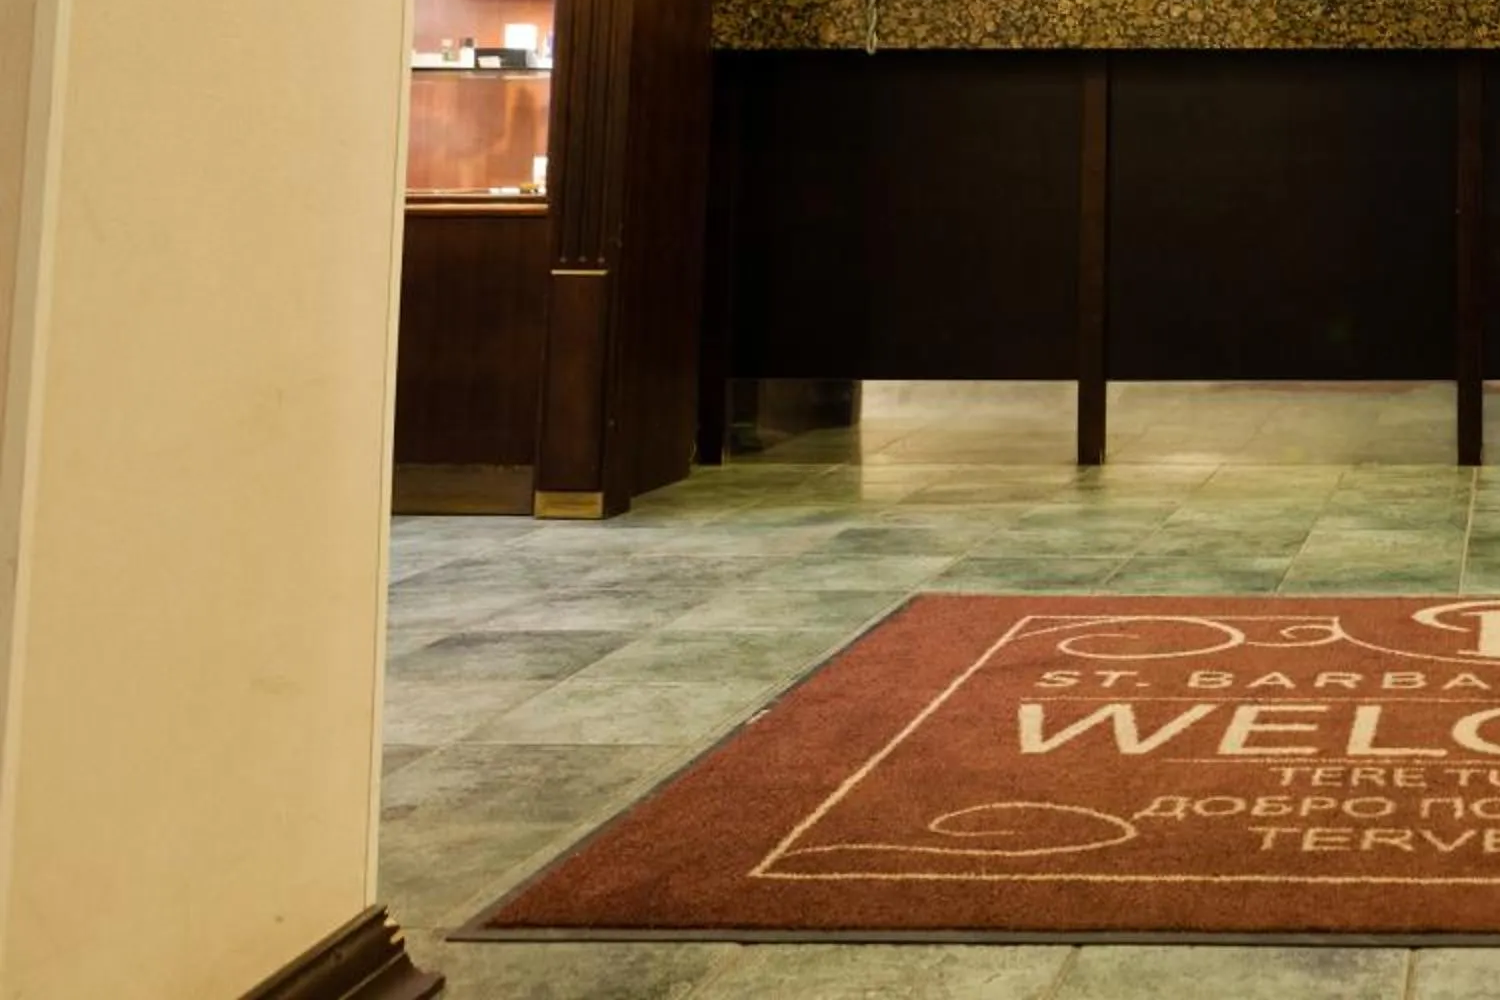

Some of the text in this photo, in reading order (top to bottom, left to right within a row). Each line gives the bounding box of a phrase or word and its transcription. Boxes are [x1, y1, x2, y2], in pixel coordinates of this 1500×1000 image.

[1035, 669, 1150, 688] ST.
[1269, 766, 1427, 787] TERE
[1132, 795, 1396, 820] ДОБРО
